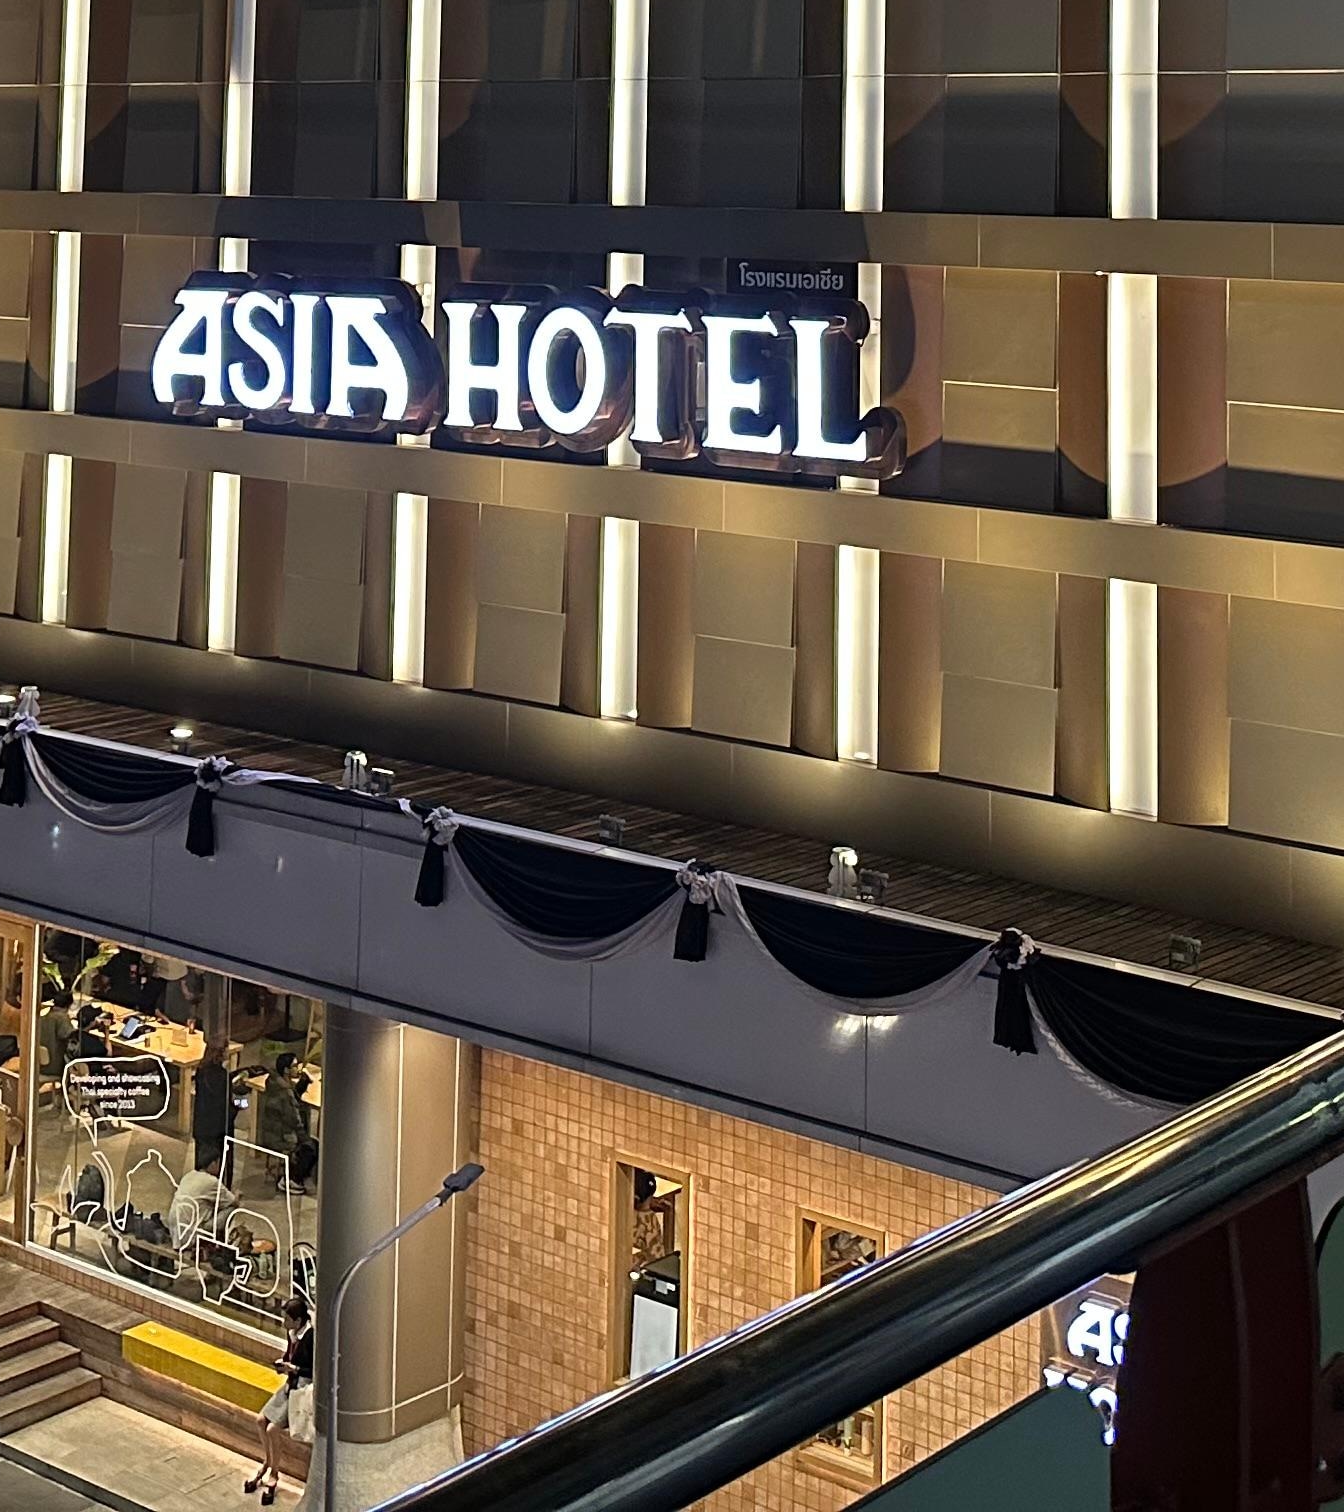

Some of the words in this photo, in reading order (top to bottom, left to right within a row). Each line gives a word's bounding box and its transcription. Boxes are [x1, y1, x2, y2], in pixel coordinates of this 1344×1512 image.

[738, 262, 844, 290] โรงแรมเอเชีย
[150, 289, 411, 422] ASIA
[440, 299, 870, 463] HOTEL
[108, 1073, 121, 1083] and
